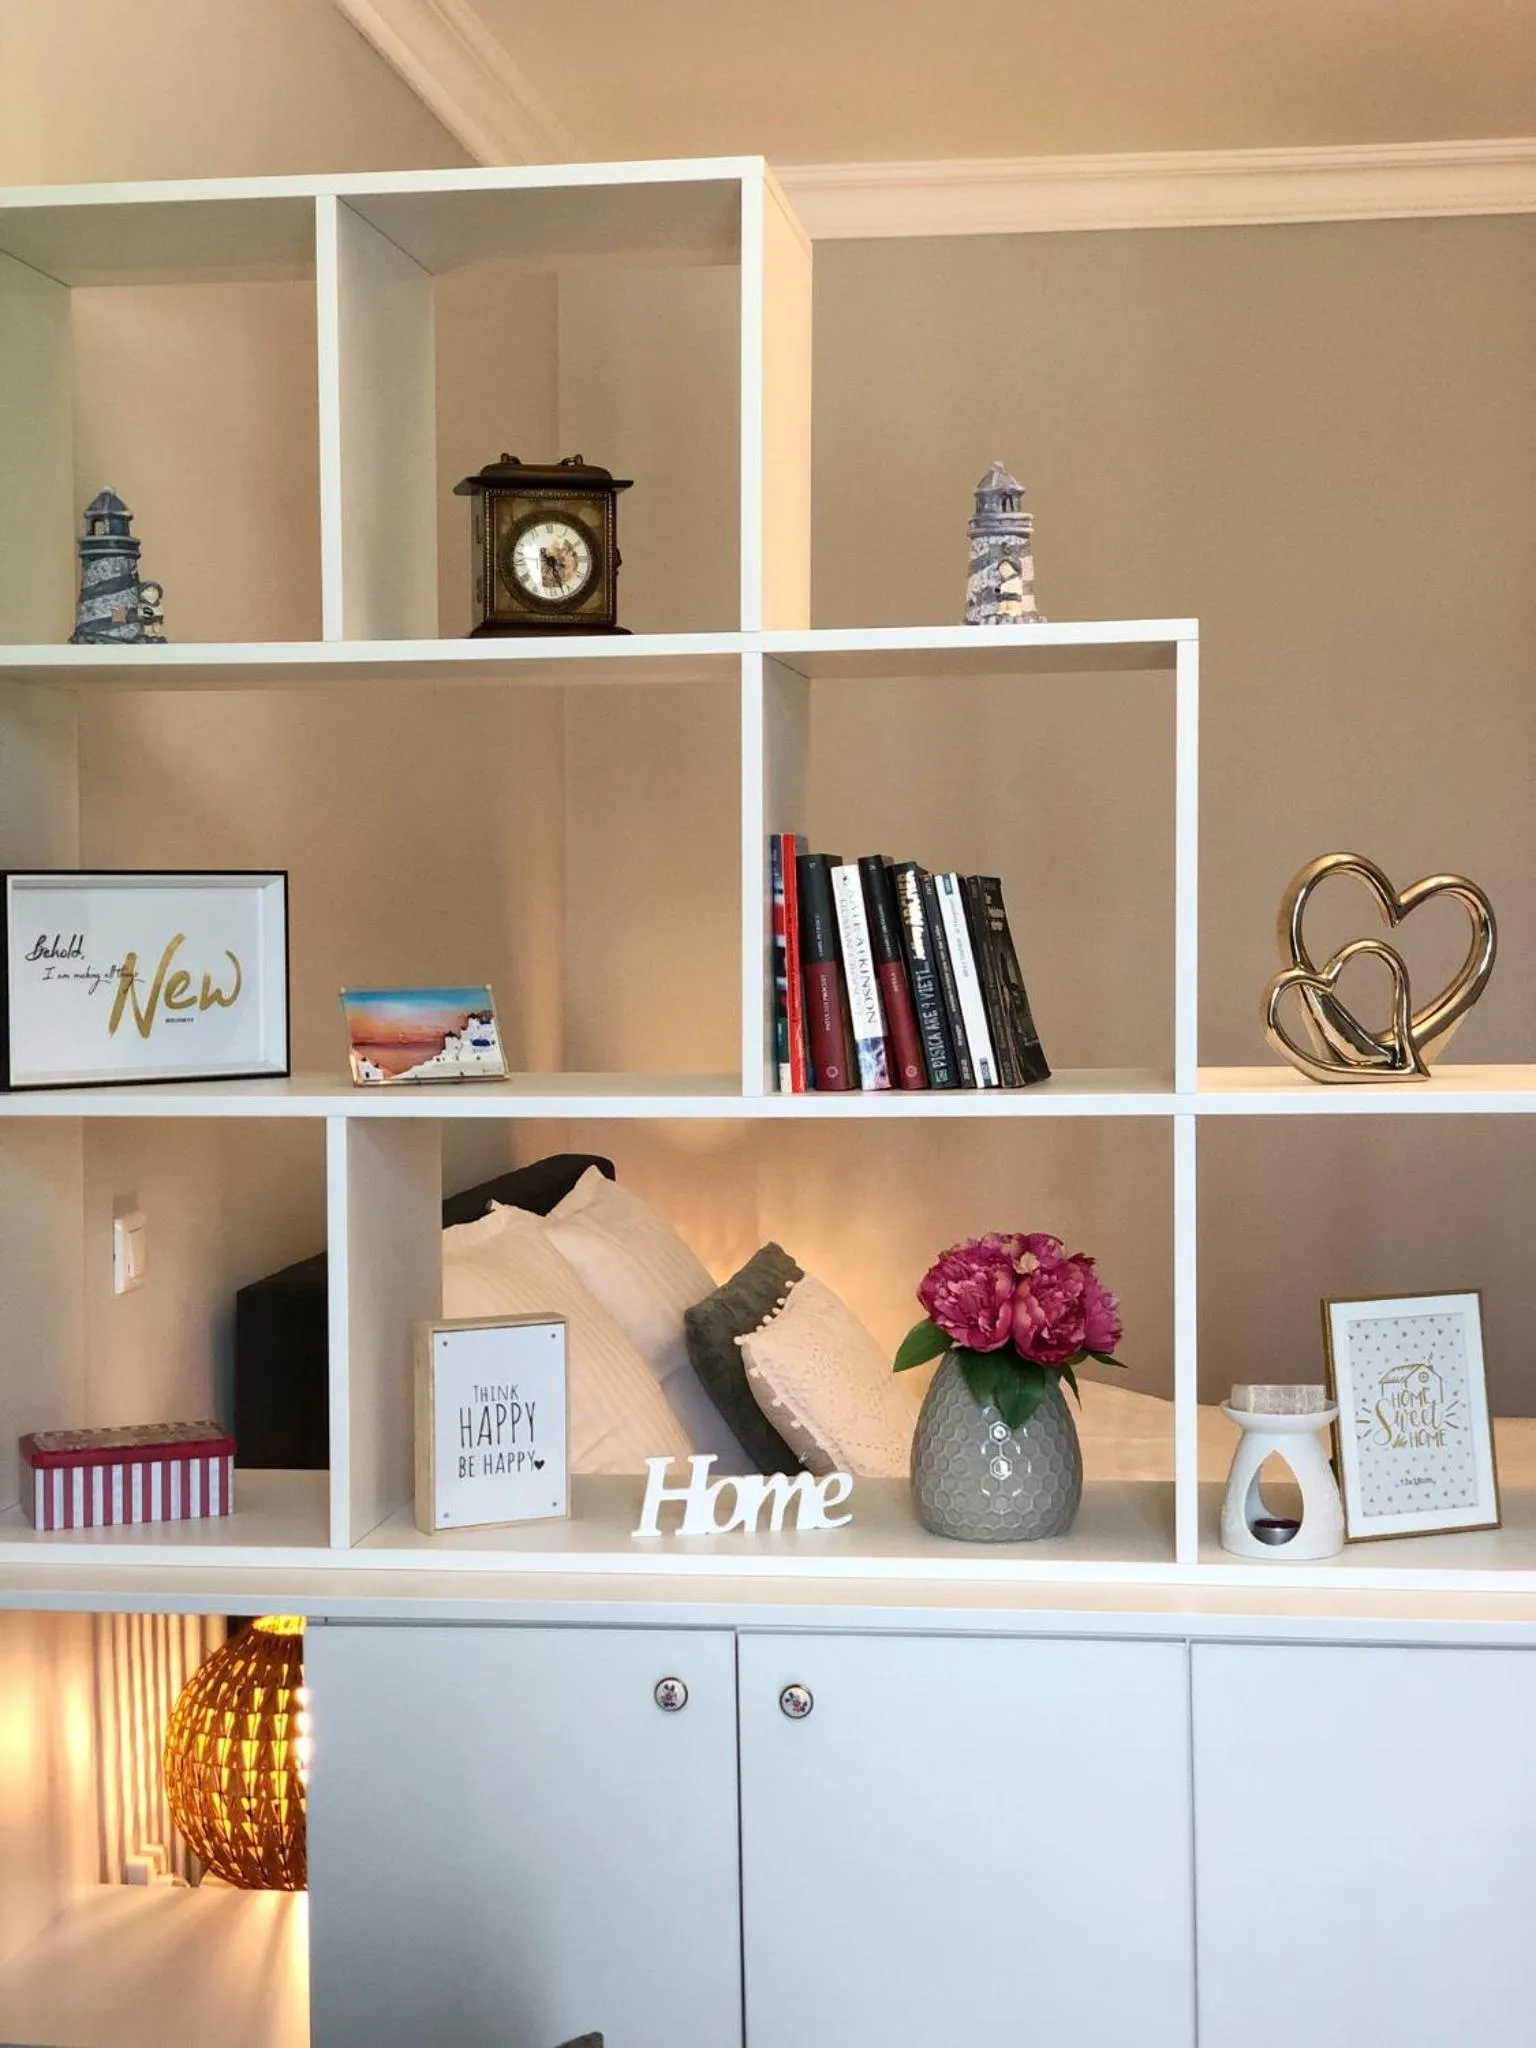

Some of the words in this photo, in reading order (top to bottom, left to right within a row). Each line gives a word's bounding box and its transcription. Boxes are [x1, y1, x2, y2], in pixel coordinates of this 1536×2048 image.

[42, 966, 55, 981] I
[73, 965, 111, 995] making
[108, 933, 242, 1039] New
[472, 1384, 519, 1402] THINK
[1391, 1387, 1431, 1409] HOME
[459, 1401, 536, 1448] HAPPY
[1409, 1428, 1447, 1448] HOME
[458, 1455, 475, 1478] BE
[483, 1450, 536, 1476] HAPPY
[631, 1454, 854, 1538] Home
